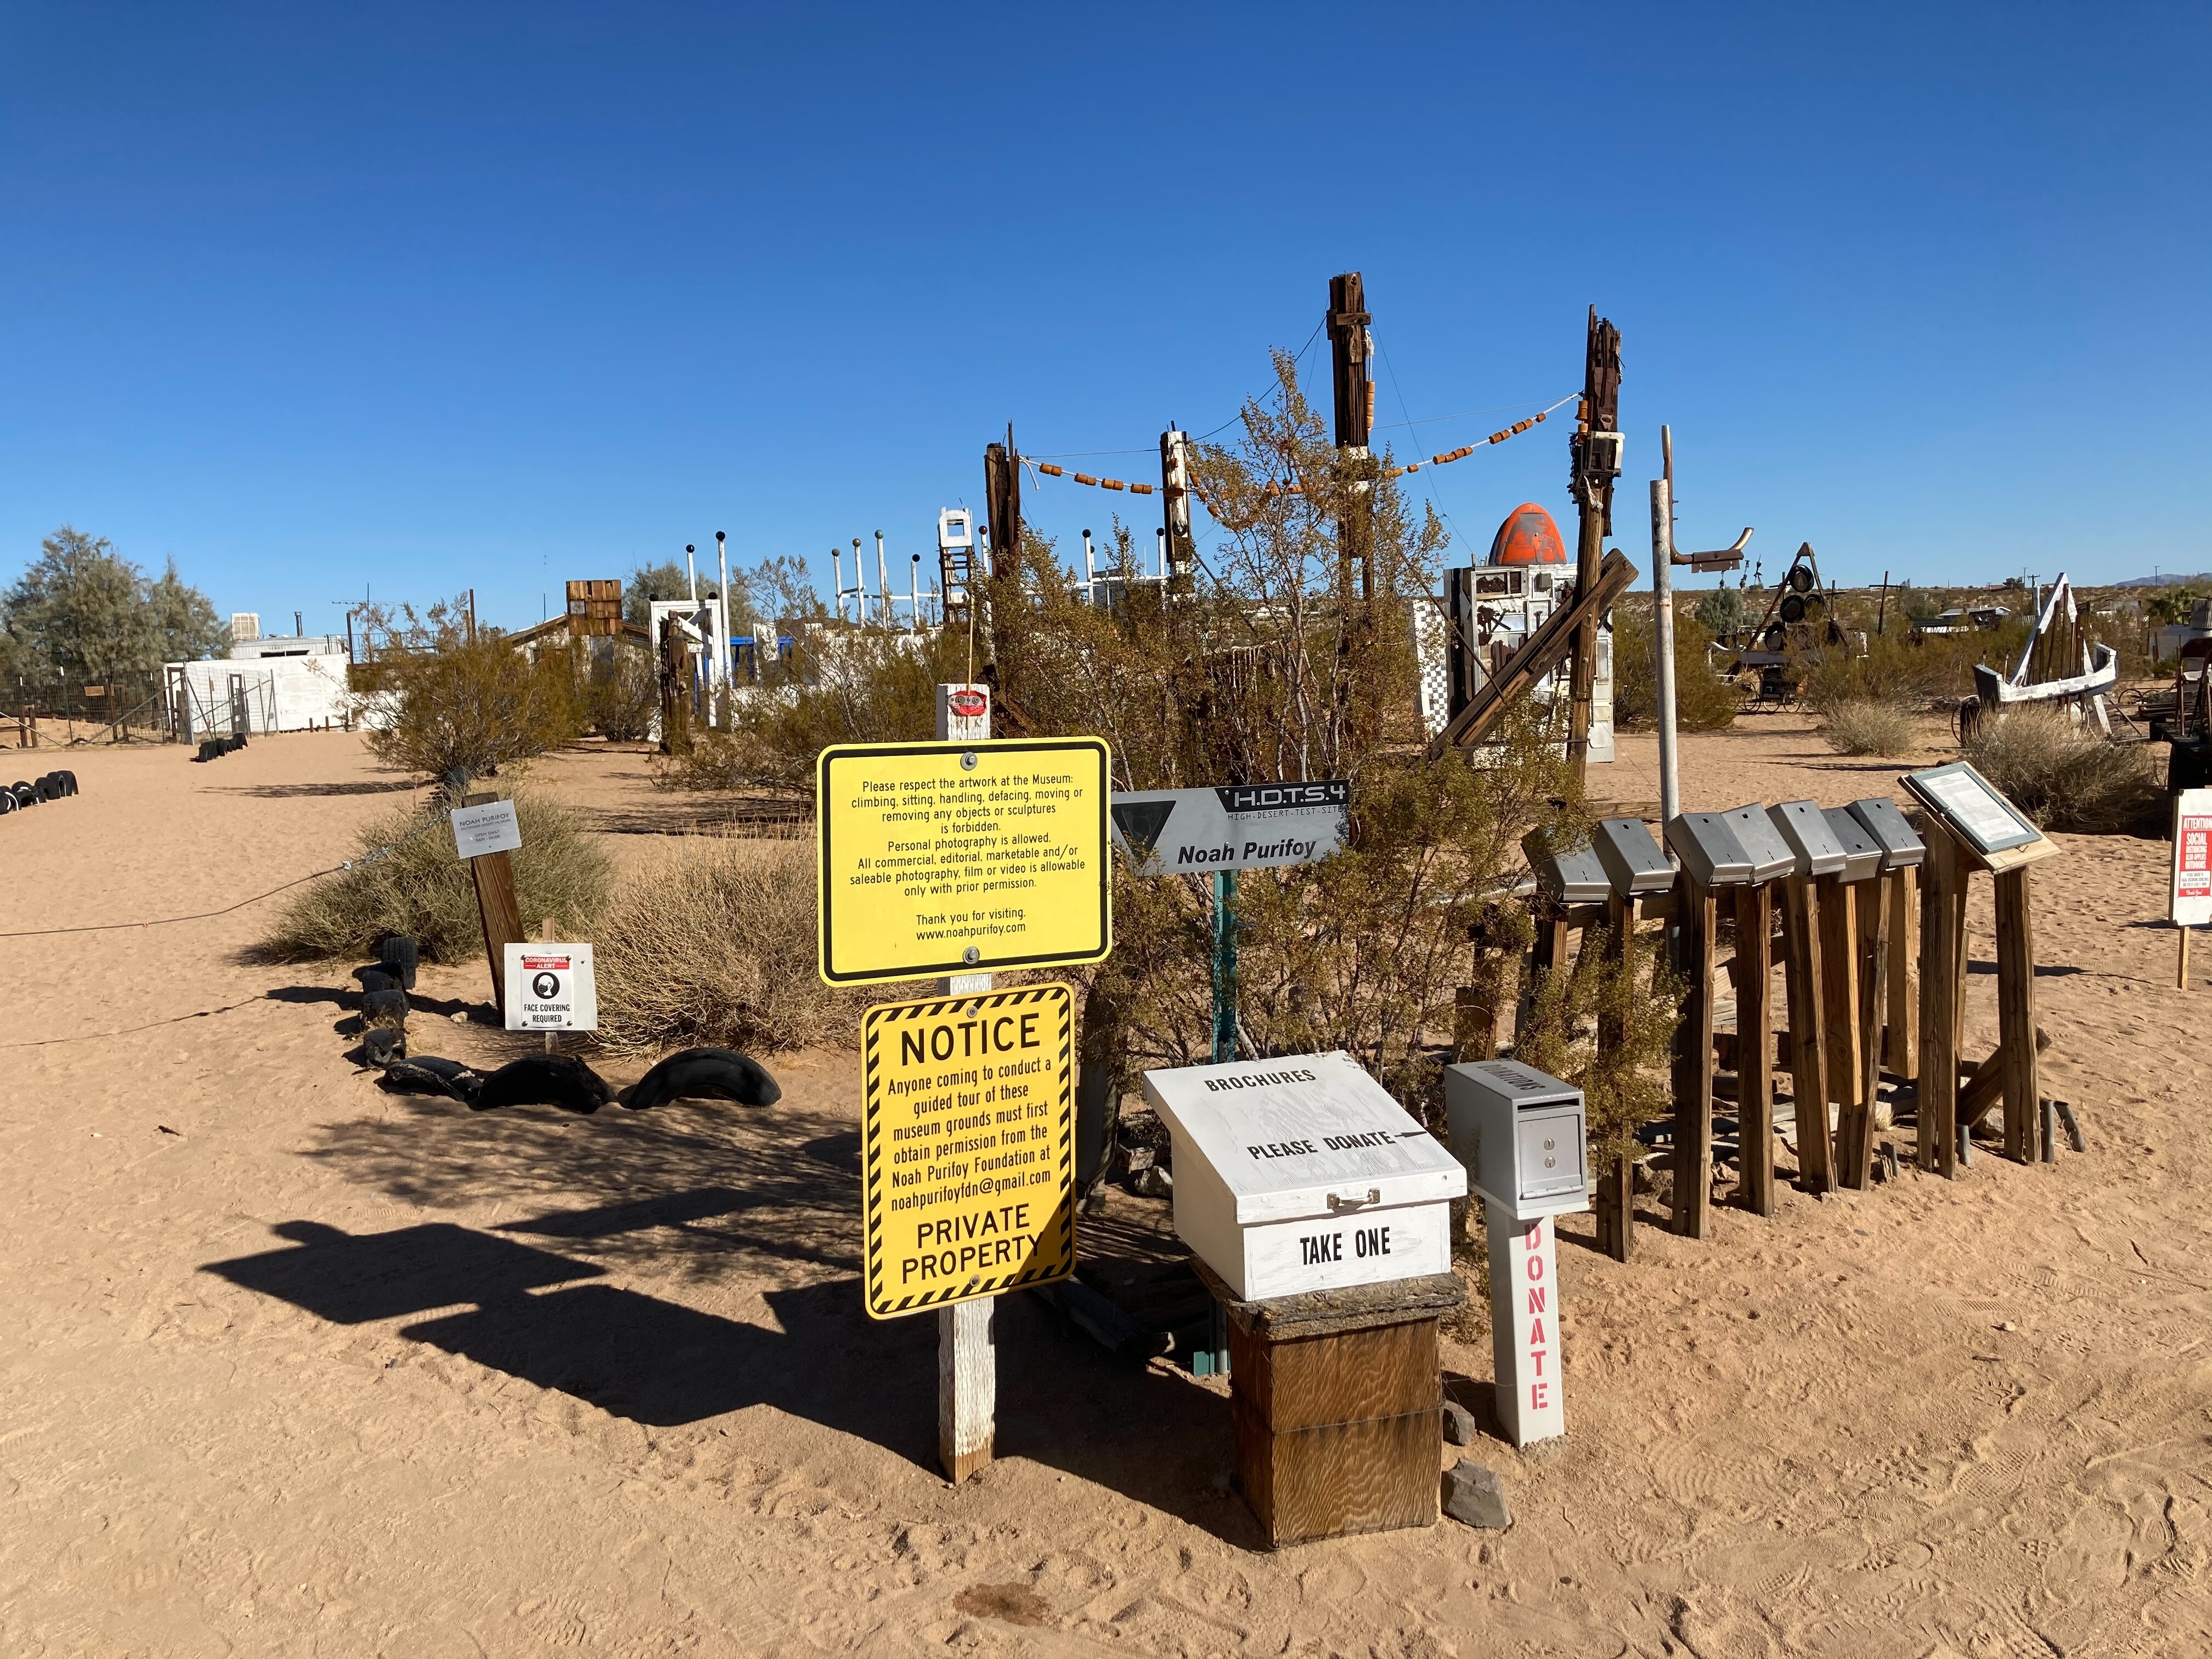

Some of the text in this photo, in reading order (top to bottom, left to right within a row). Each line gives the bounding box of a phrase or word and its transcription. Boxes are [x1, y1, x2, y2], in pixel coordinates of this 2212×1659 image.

[863, 774, 1073, 793] Please respect the artwork at the Museum:
[851, 788, 1083, 810] climbing, sitting, handling, defacing, moving or
[459, 813, 509, 827] NOAH PURIFOY
[882, 803, 1056, 823] removing any objects or sculptures
[2183, 817, 2212, 830] ATTENTION
[941, 821, 1001, 834] is forbidden.
[2186, 832, 2208, 845] SOCIAL
[888, 832, 1051, 852] Personal photography is allowed.
[1177, 838, 1317, 865] Noah Purifoy
[857, 844, 1078, 870] All commercial, editorial, marketable and/or
[850, 859, 1085, 885] saleable photography, film or video is allowable
[904, 877, 1036, 898] only with prior permission.
[916, 907, 1025, 926] Thank you for visiting.
[916, 923, 1025, 940] www.noahpurifoy.com
[532, 1014, 562, 1023] REQUIRED
[901, 1012, 1040, 1066] NOTICE
[888, 1057, 1051, 1097] Anyone coming to conduct a
[1204, 1069, 1316, 1092] BROCHURES
[1477, 1064, 1545, 1090] DONATIONS
[913, 1084, 1029, 1120] guided tour of these
[894, 1100, 1048, 1142] museum grounds must first
[894, 1124, 1047, 1165] obtain permission from the
[1246, 1131, 1395, 1160] PLEASE DONATE
[892, 1144, 1051, 1188] Noah Purifoy Foundation at
[891, 1170, 1051, 1211] noahpurifoyfdn@gmail.com
[918, 1203, 1030, 1249] PRIVATE
[902, 1232, 1043, 1284] PROPERTY
[1300, 1226, 1391, 1265] TAKE ONE
[1524, 1223, 1548, 1409] DONATE
